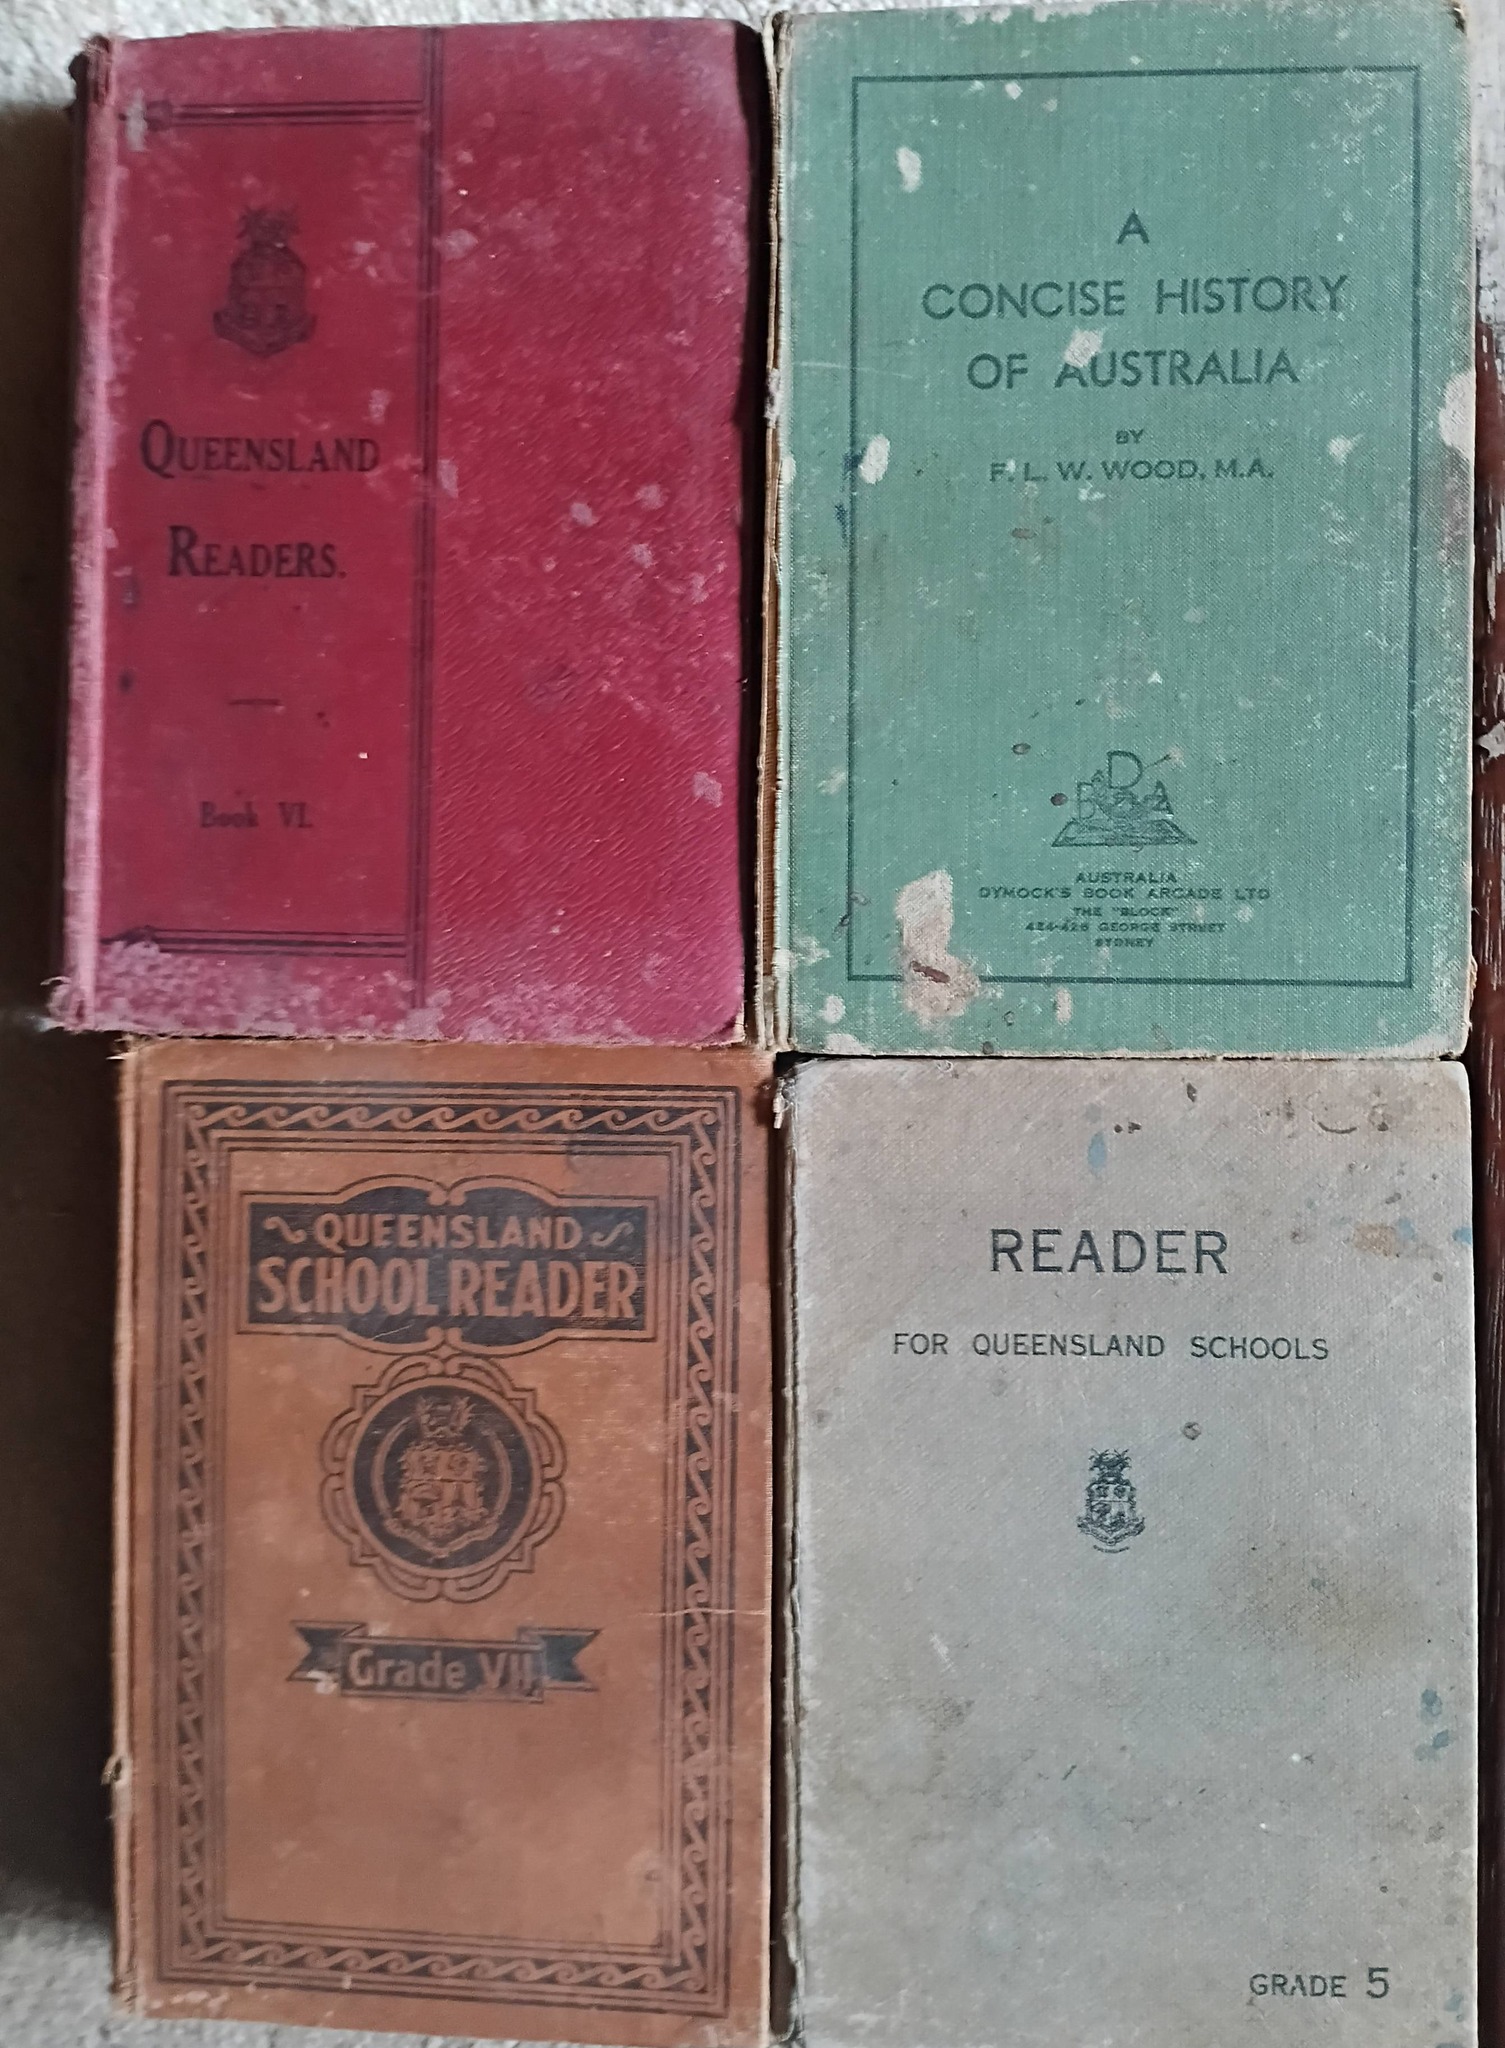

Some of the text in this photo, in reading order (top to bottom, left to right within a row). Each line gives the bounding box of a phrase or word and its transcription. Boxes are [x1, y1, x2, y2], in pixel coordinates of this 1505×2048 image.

[1117, 208, 1149, 244] A
[922, 275, 1348, 320] CONCISE HISTORY
[967, 347, 1299, 389] OF AUSTRALIA
[1115, 429, 1144, 444] BY
[1024, 462, 1048, 481] L.
[1057, 460, 1092, 481] W.
[1102, 459, 1206, 480] WOOD,
[1215, 458, 1275, 478] M.A.
[168, 525, 347, 578] READERS.
[979, 886, 1271, 900] DYMOCK'S BOOK ARCADE LTD
[1075, 871, 1178, 884] AUSTRALIA
[1073, 906, 1102, 917] THE
[1099, 922, 1161, 932] GEORGE
[1168, 922, 1227, 933] STREET
[1095, 937, 1154, 948] SYDNEY
[314, 1212, 583, 1253] QUEENSLAND
[989, 1228, 1229, 1274] READER
[256, 1255, 639, 1319] SCHOOL READER
[893, 1333, 1329, 1360] FOR QUEENSLAND SCHOOLS
[350, 1648, 467, 1690] Grade
[1250, 1966, 1390, 1999] GRADE 5
